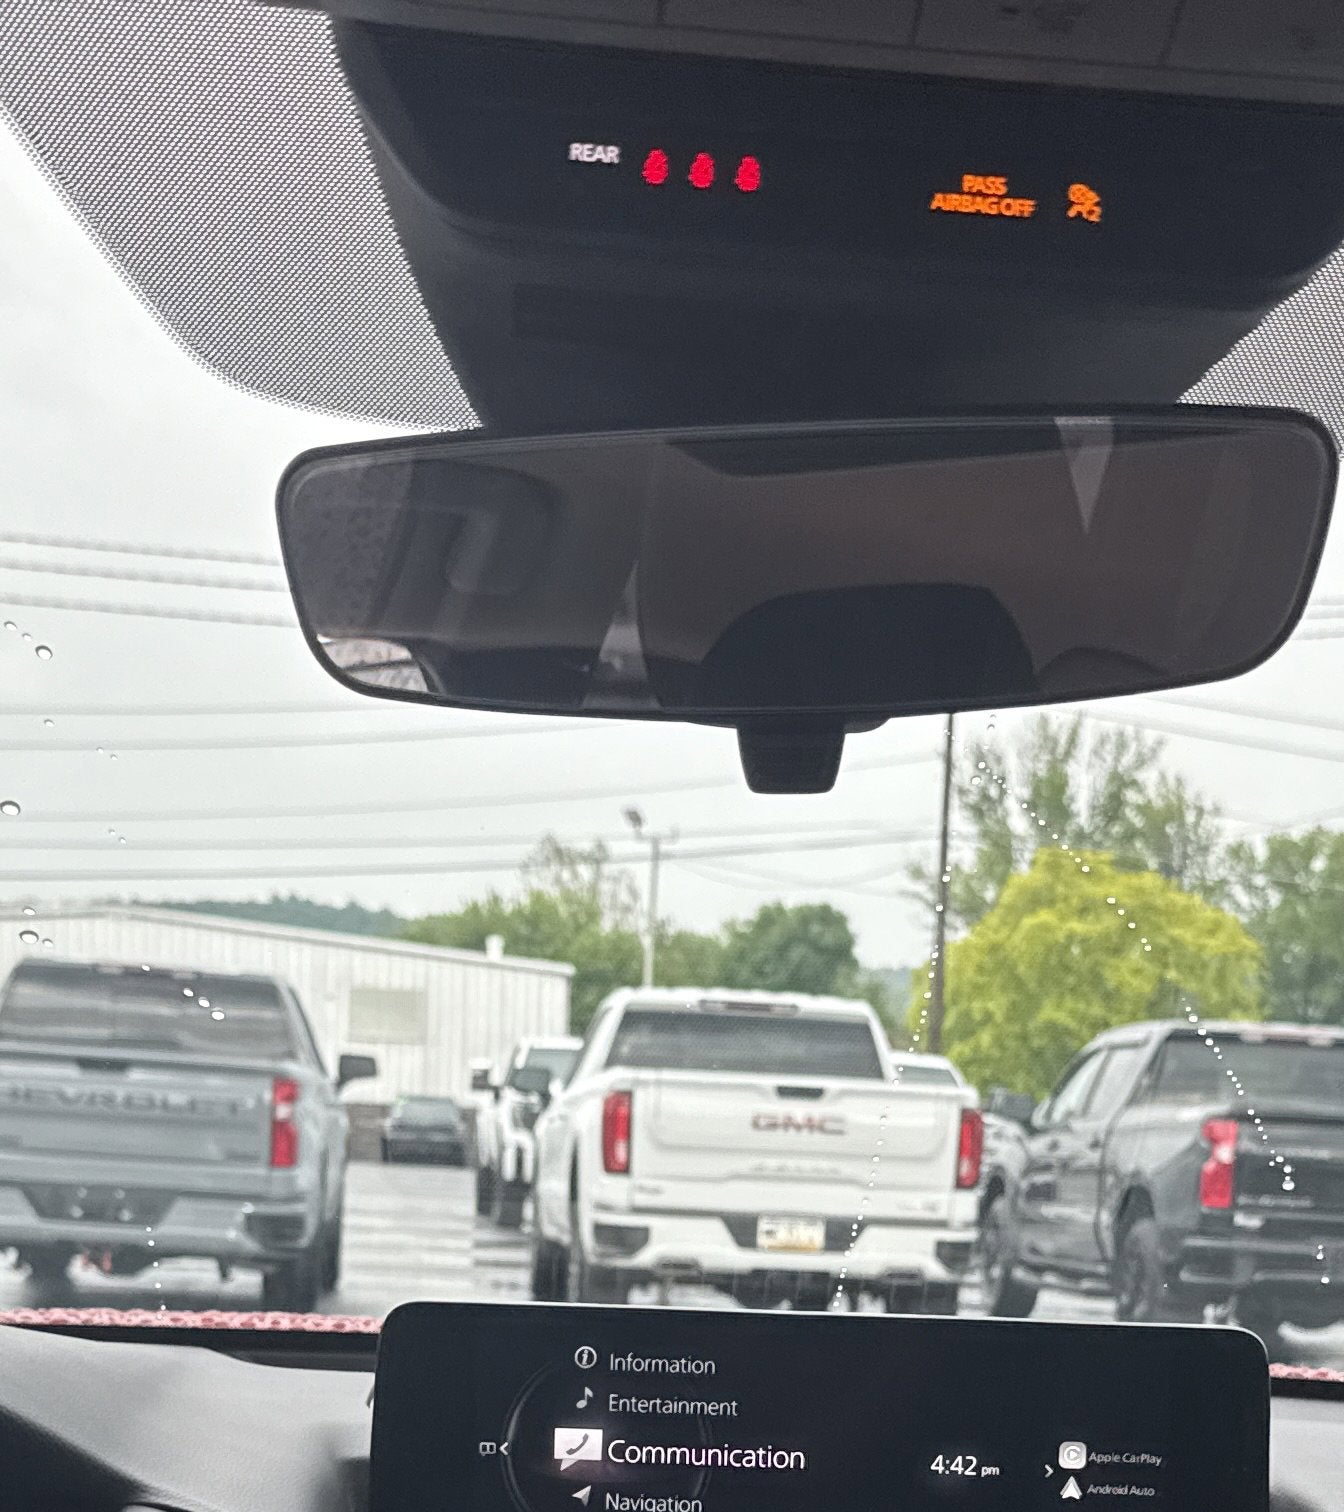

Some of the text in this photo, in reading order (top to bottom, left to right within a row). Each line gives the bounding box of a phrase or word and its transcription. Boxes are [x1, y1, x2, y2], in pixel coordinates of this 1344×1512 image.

[569, 144, 620, 163] REAR
[962, 175, 1007, 195] PASS
[931, 194, 1035, 218] AIRBAG OFF
[752, 1113, 847, 1136] GMC
[610, 1353, 716, 1375] Information
[608, 1394, 738, 1417] Entertainment
[608, 1440, 806, 1469] Communication
[1088, 1452, 1162, 1466] Apple CarPlay
[930, 1455, 999, 1477] 4:42 pm
[1087, 1484, 1154, 1496] Android Auto
